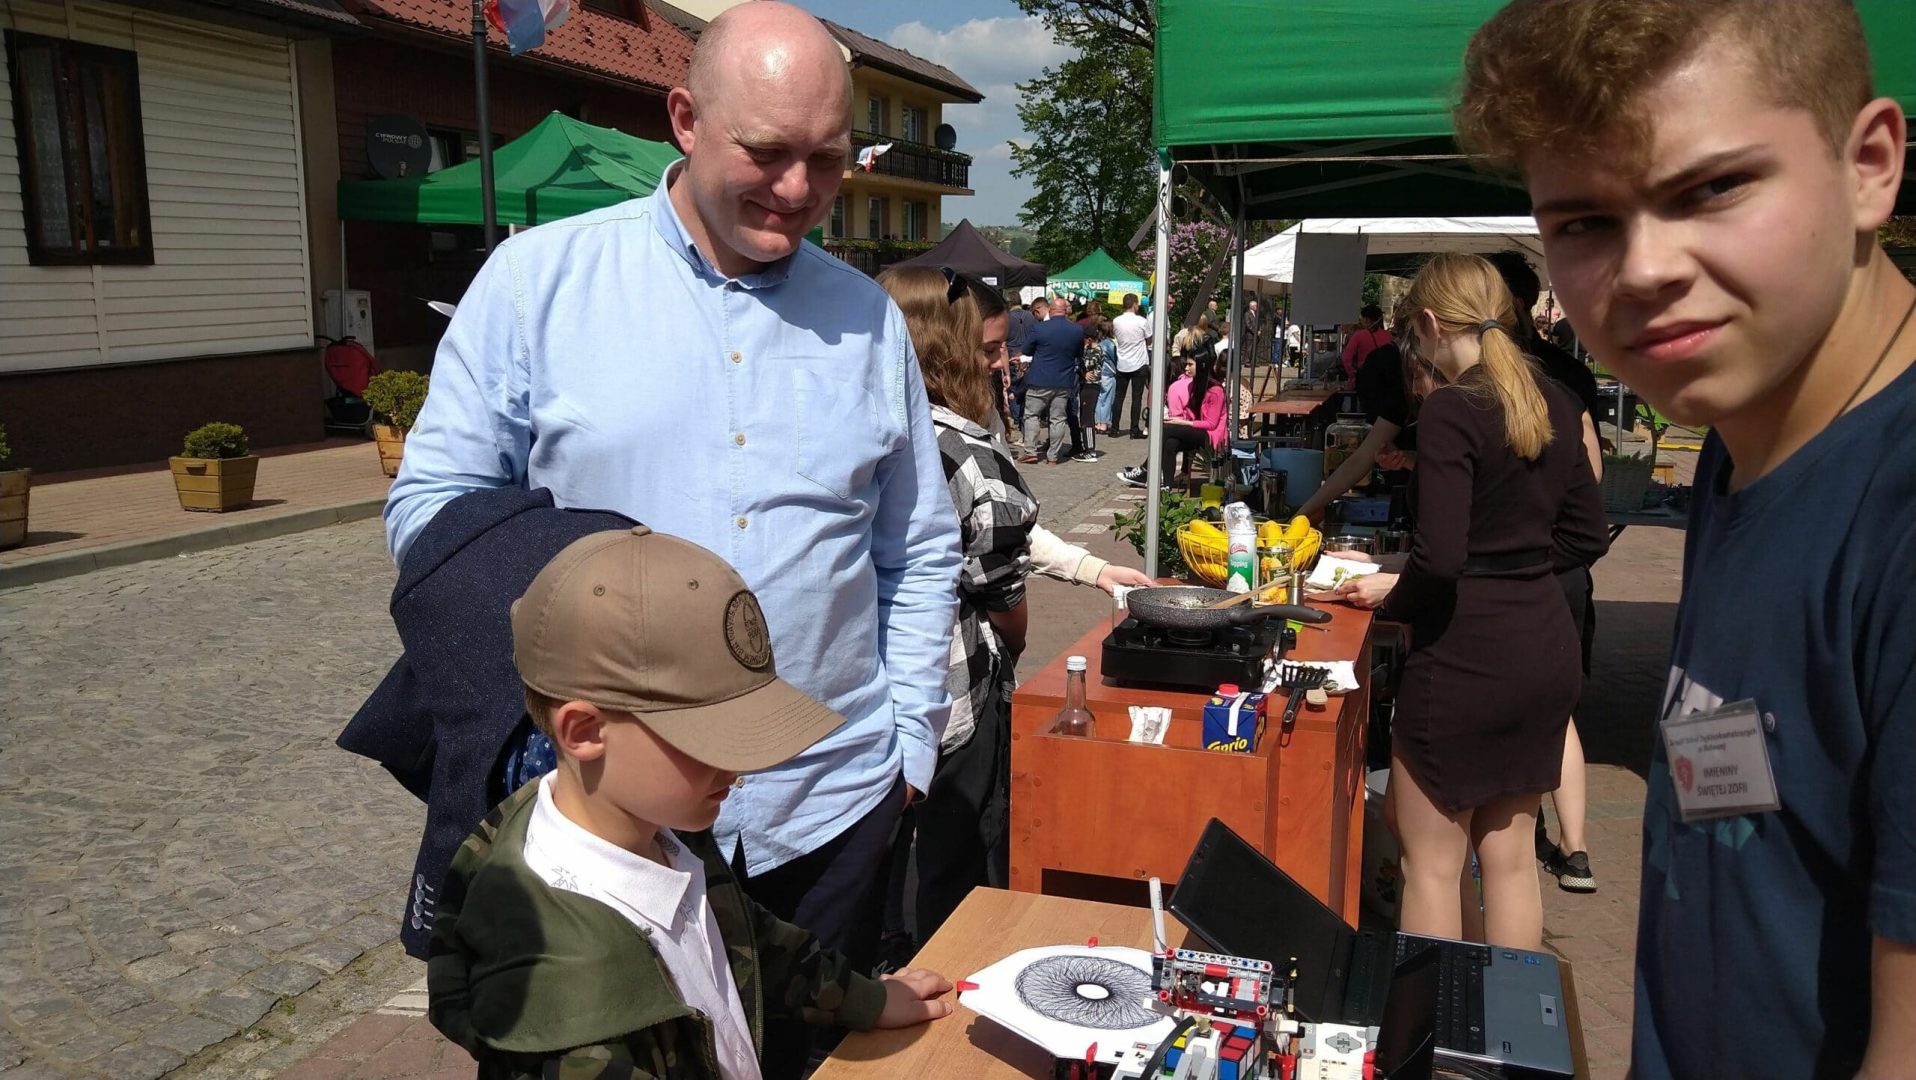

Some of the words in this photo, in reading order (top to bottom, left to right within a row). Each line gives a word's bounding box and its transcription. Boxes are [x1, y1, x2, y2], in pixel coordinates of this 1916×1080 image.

[1703, 765, 1738, 778] IMIENINY
[1697, 784, 1727, 797] ŚWIĘTEJ
[1728, 782, 1748, 794] ZOFII
